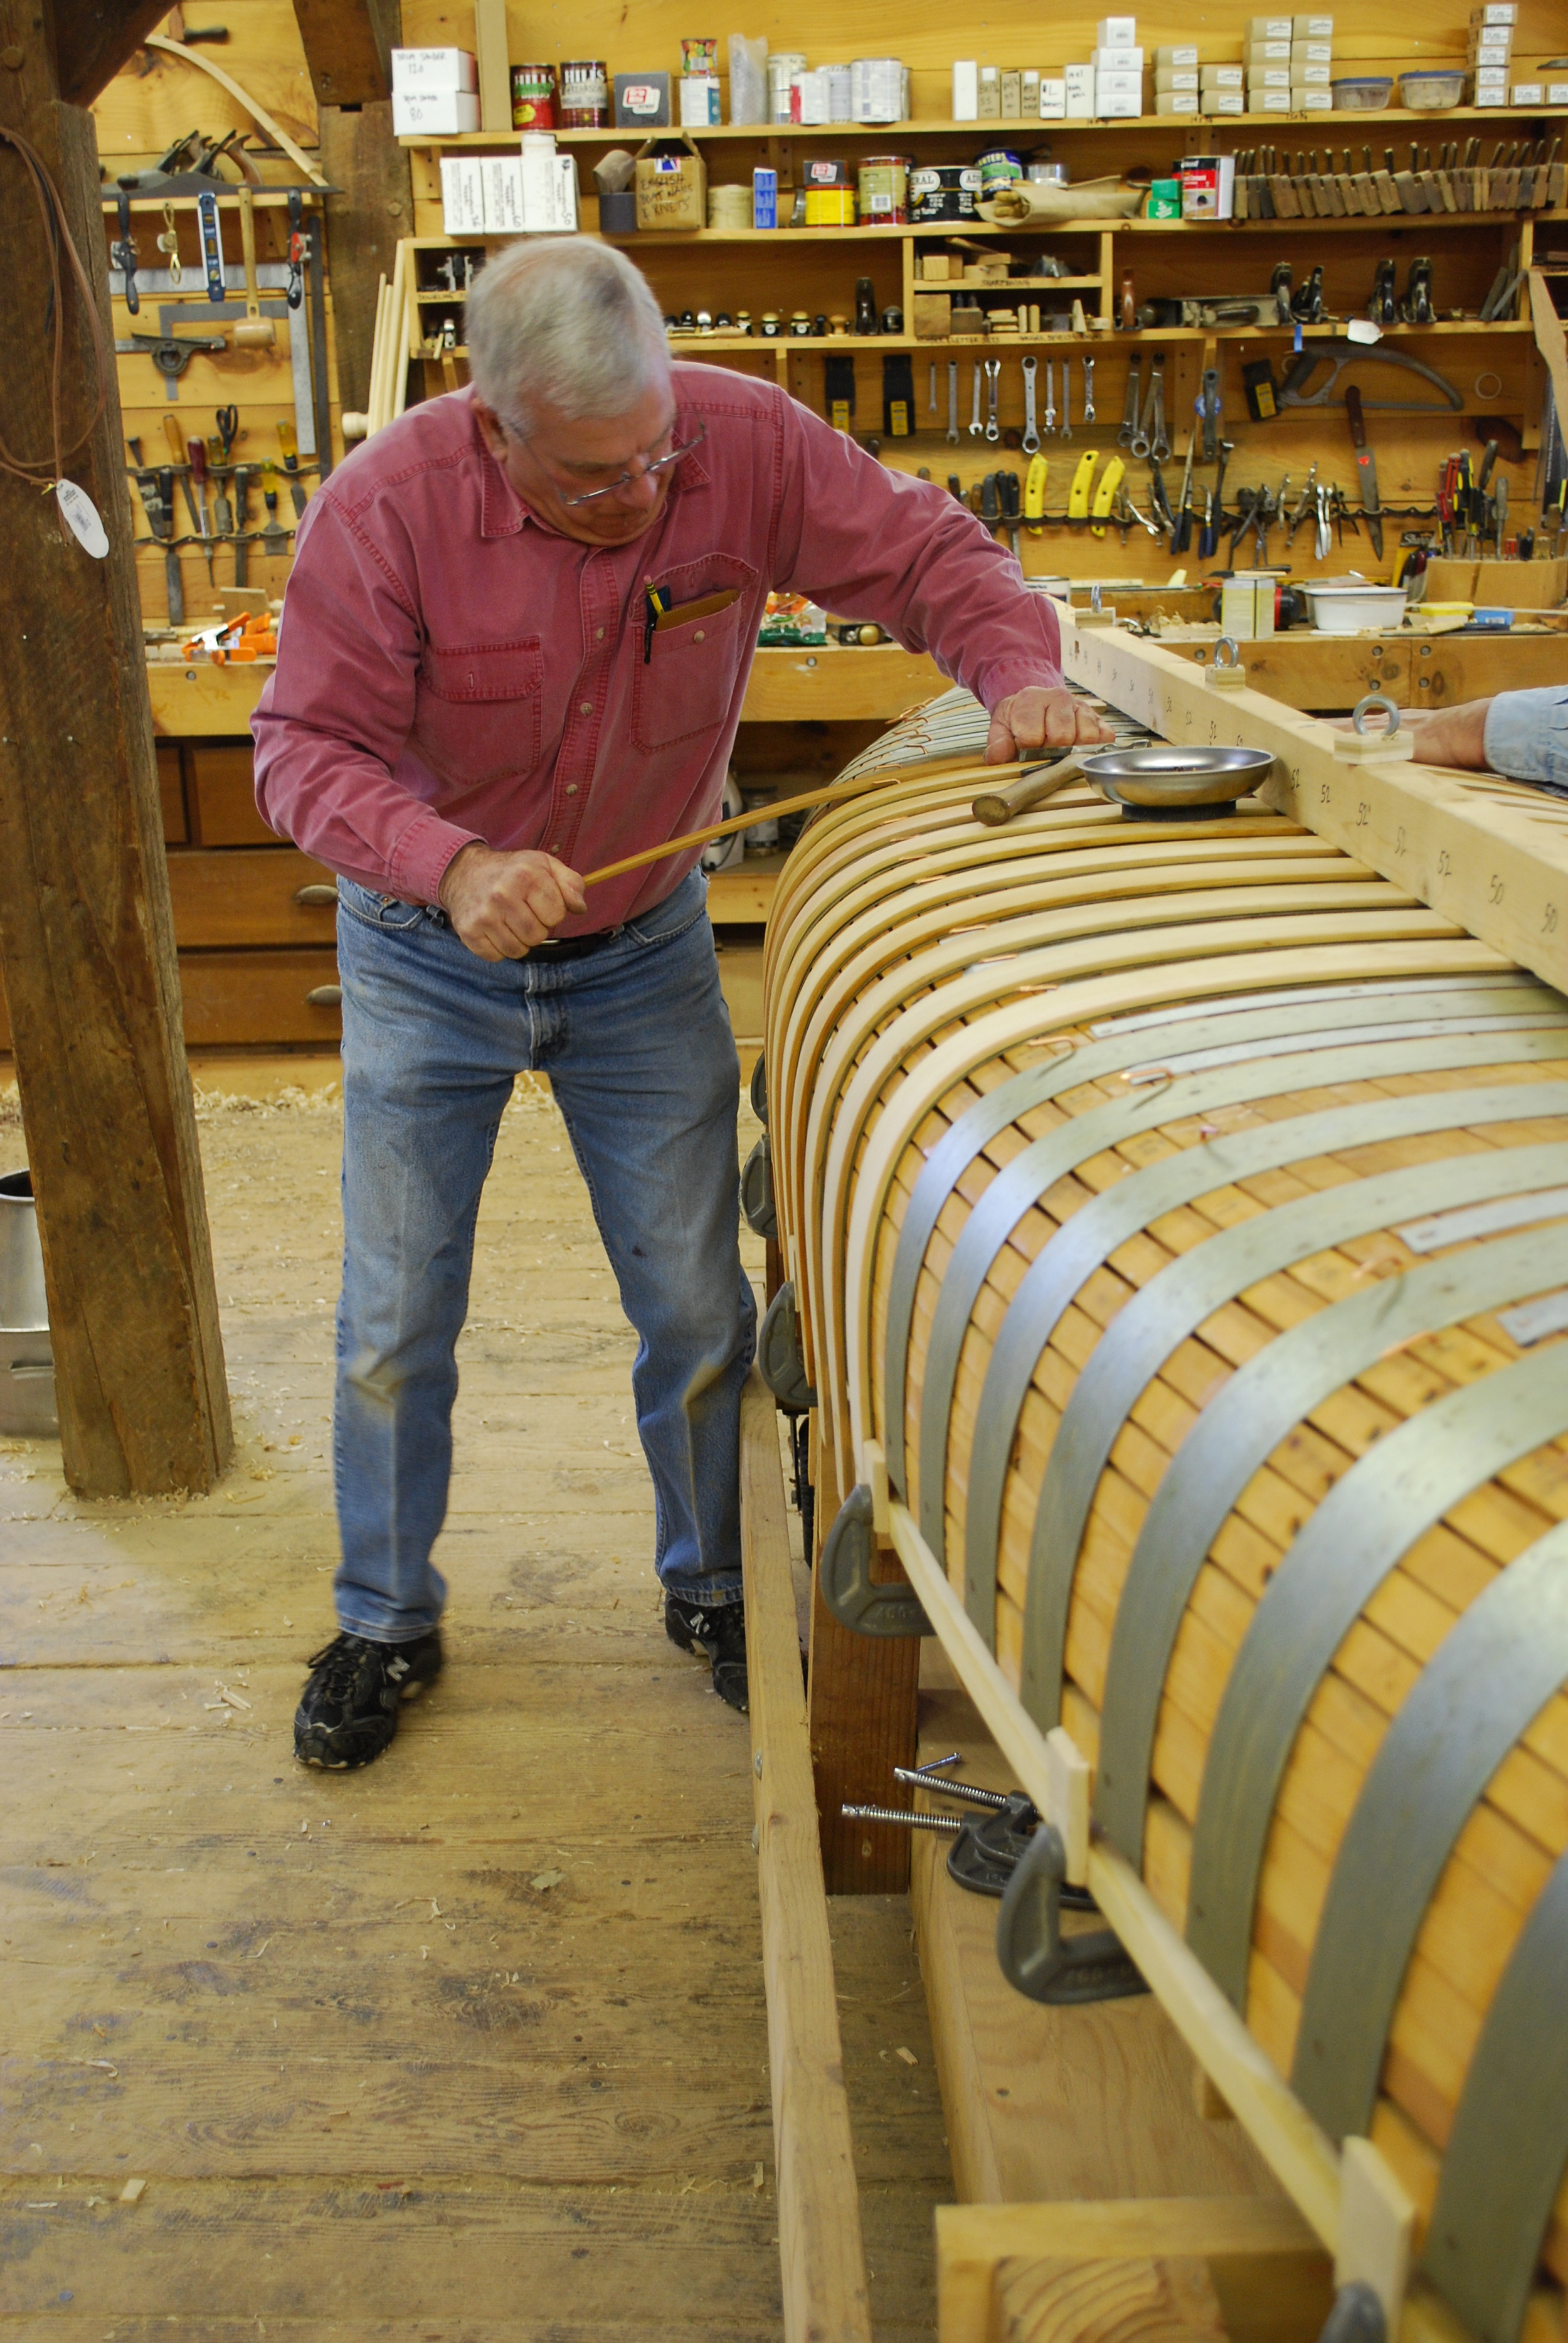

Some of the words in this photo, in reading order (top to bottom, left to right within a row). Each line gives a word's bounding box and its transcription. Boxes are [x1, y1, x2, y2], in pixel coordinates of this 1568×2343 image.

[410, 107, 423, 122] 80
[1291, 768, 1300, 790] 52
[1321, 784, 1330, 803] 52
[1438, 850, 1452, 876] 52
[1488, 874, 1505, 905] 50
